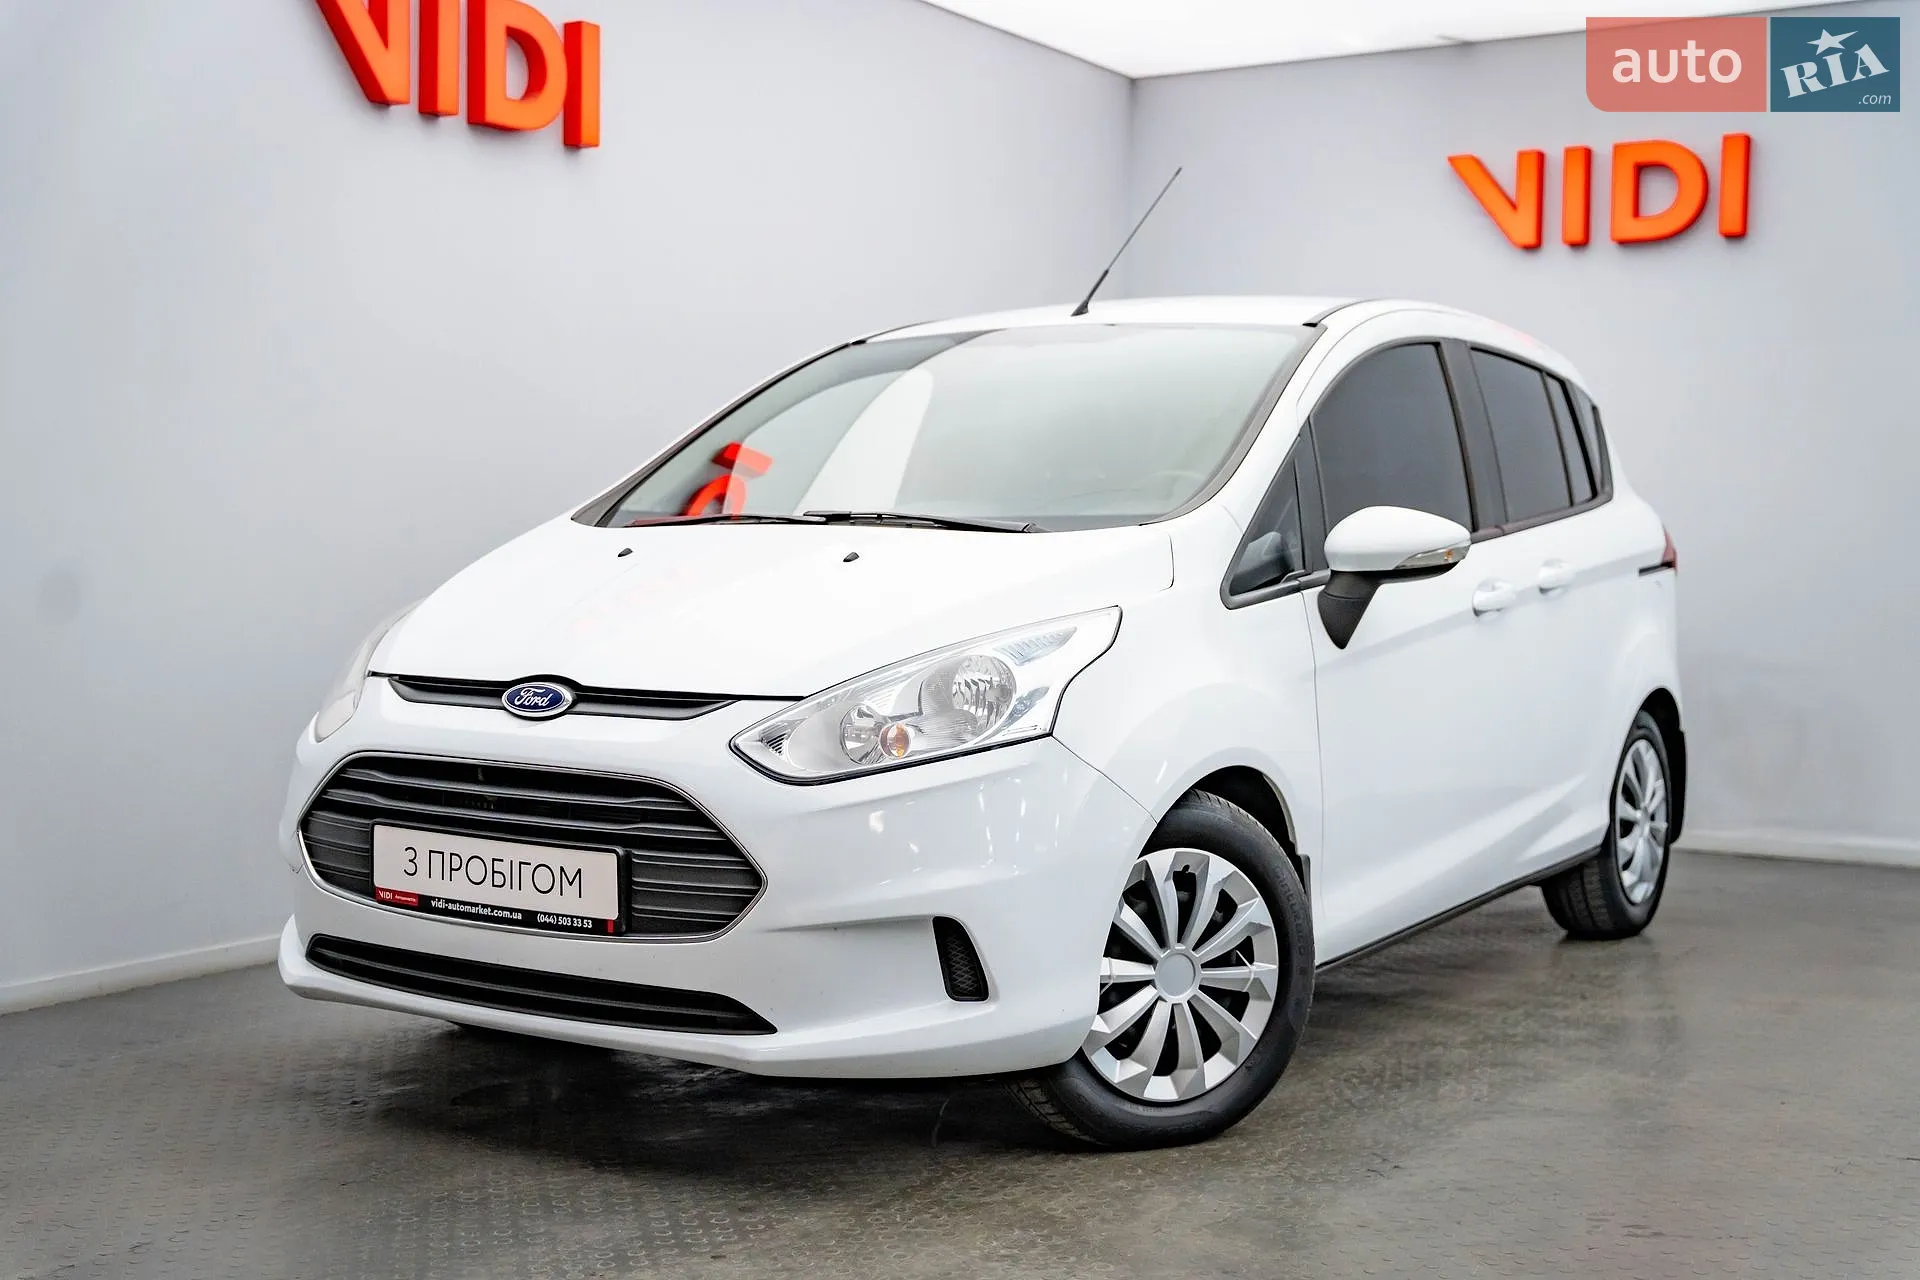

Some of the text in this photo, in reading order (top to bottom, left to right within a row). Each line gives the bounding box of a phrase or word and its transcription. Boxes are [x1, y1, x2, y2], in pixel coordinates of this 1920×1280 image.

[313, 0, 600, 148] VIDI
[1447, 132, 1751, 249] VIDI
[514, 687, 553, 707] Ford
[428, 849, 583, 899] ПРОБІГОМ
[378, 890, 393, 900] VIDI
[431, 898, 593, 929] vidi-automarket.com.ua (044) 503 33 53
